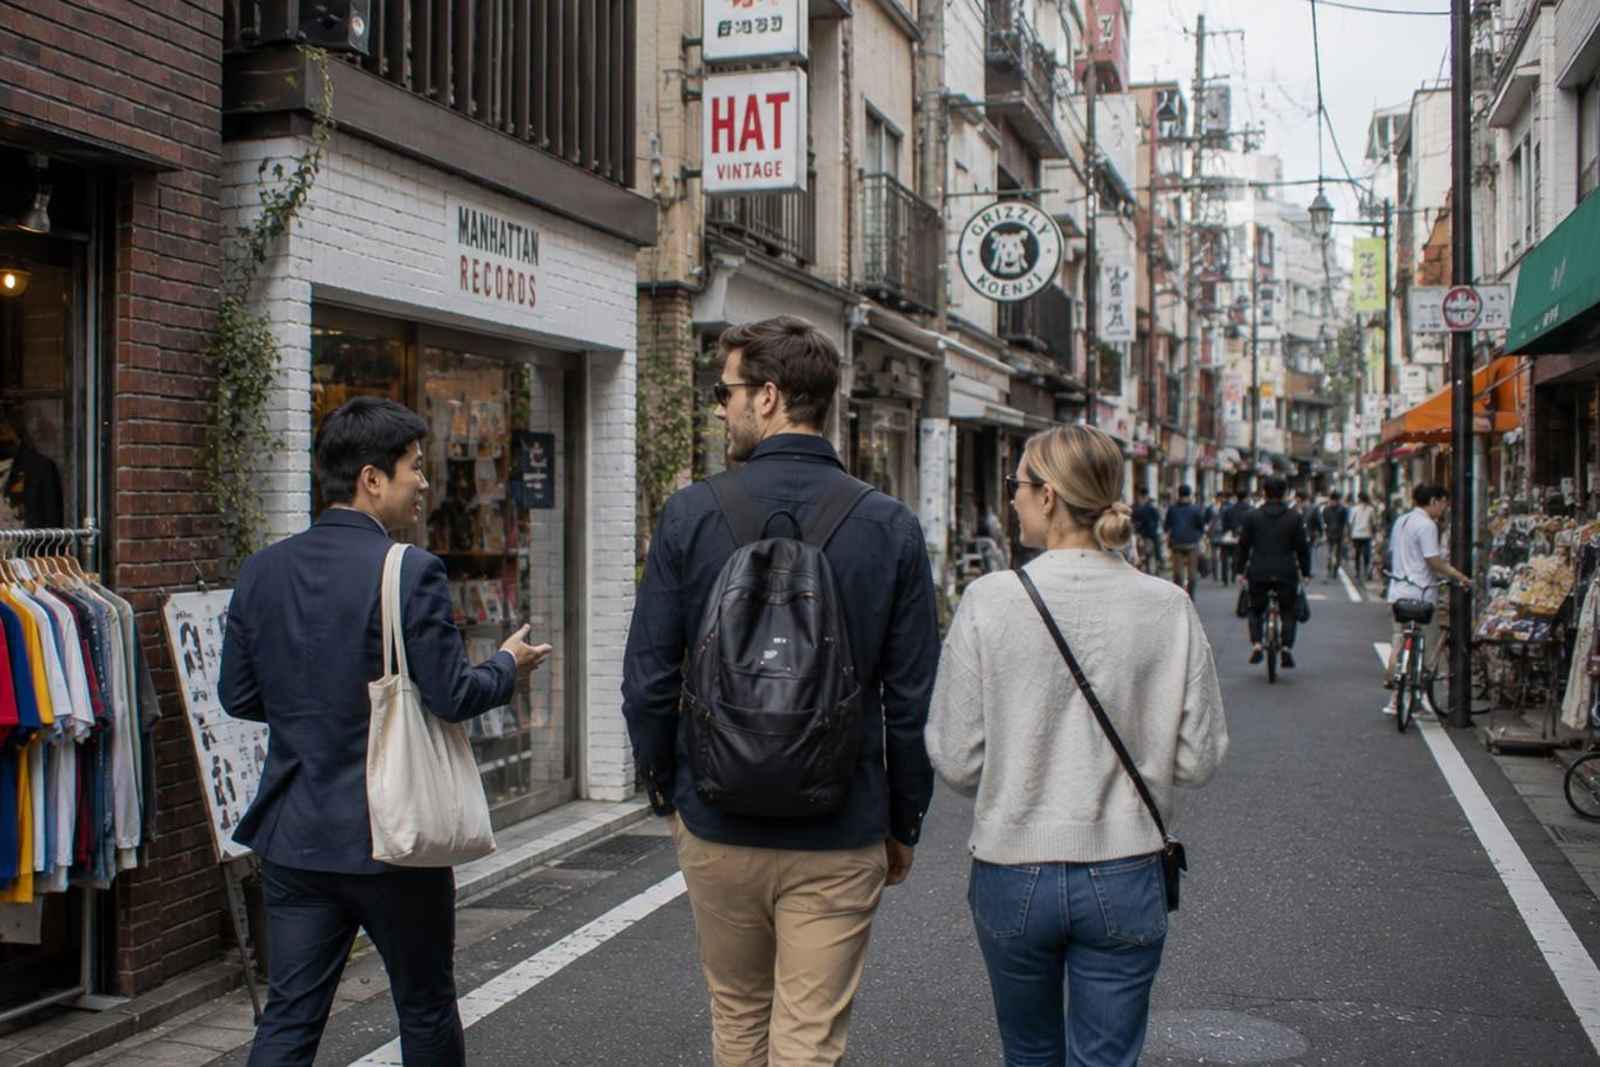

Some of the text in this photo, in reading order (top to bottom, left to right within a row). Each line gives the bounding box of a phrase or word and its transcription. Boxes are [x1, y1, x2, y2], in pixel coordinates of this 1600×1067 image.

[711, 92, 790, 154] HAT
[716, 160, 783, 180] VINTAGE
[458, 205, 539, 267] MANHATTAN
[971, 206, 1049, 236] GRIZZLY
[460, 254, 537, 308] RECORDS
[977, 272, 1042, 297] KOENJI
